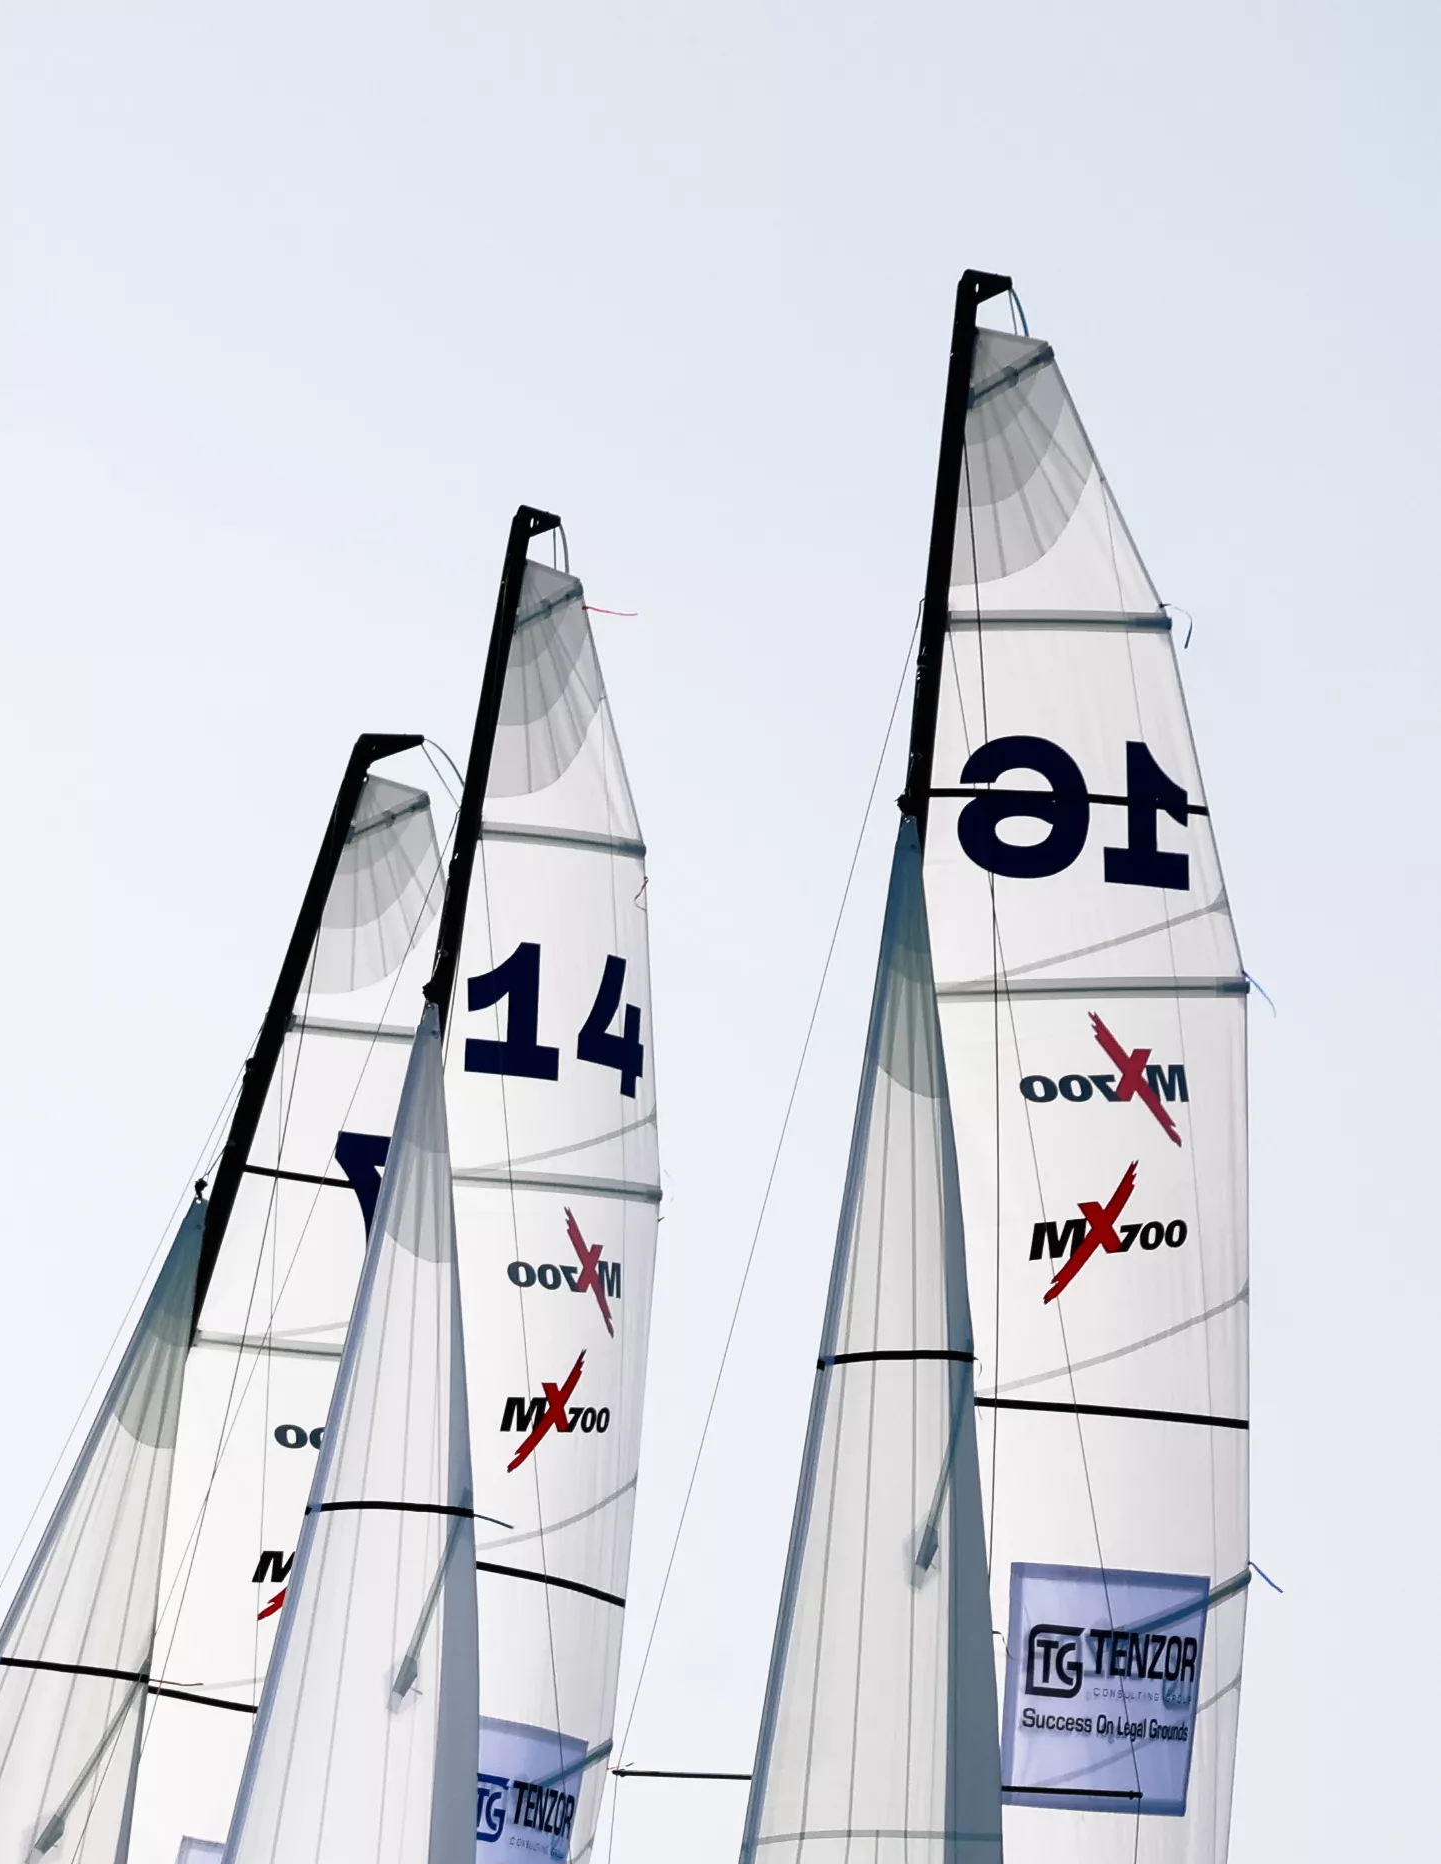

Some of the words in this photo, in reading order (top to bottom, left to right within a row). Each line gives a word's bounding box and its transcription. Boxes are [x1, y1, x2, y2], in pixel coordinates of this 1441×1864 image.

[464, 942, 645, 1099] 14
[1029, 1160, 1187, 1305] MX700
[500, 1349, 610, 1473] MX700
[1090, 1629, 1198, 1682] TENZOR
[1022, 1708, 1092, 1733] Success
[1096, 1714, 1114, 1734] On
[1117, 1716, 1146, 1742] Legal
[1149, 1718, 1188, 1742] Grounds
[513, 1780, 576, 1839] TENZOR
